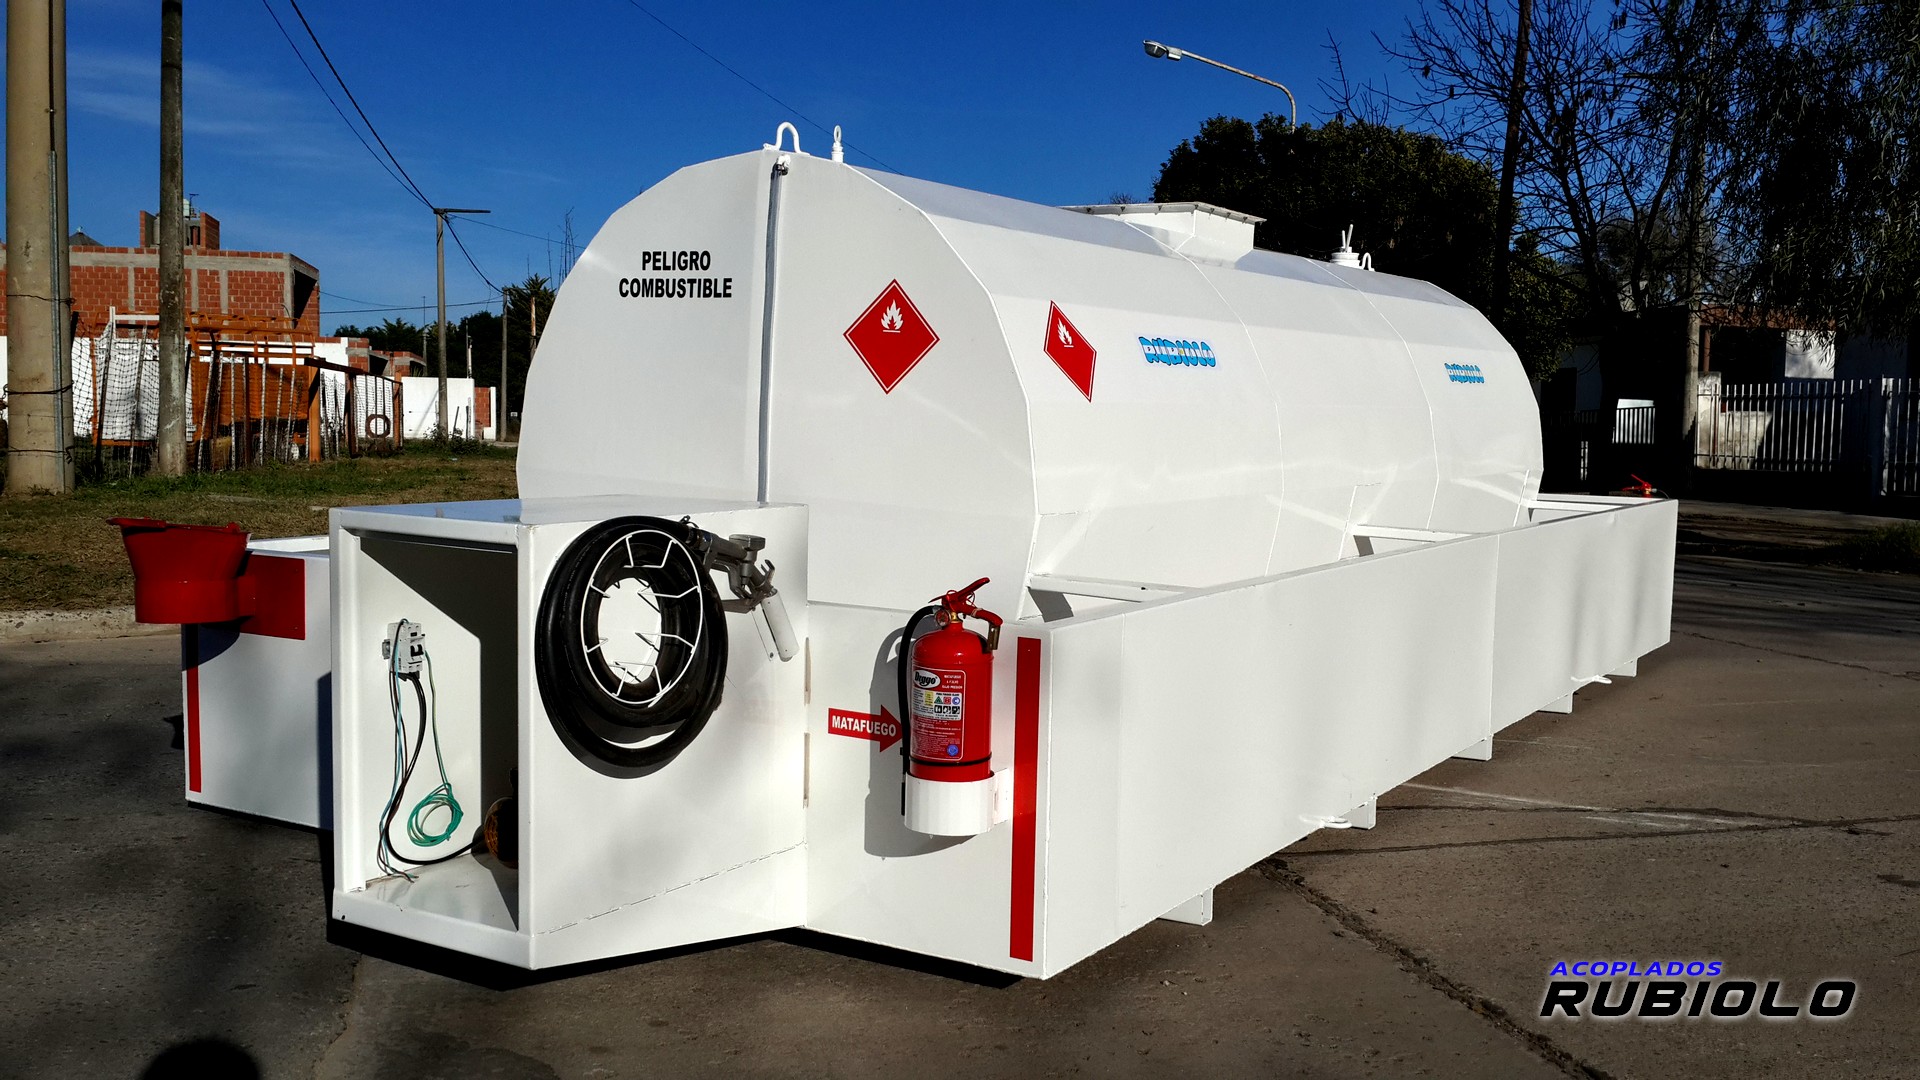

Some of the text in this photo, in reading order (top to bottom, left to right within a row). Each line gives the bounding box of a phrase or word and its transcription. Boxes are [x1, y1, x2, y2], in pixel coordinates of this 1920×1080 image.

[642, 250, 711, 271] PELIGRO
[619, 278, 733, 298] COMBUSTIBLE
[1138, 336, 1217, 367] RUBIOLO
[832, 715, 897, 737] MATAFUEGO
